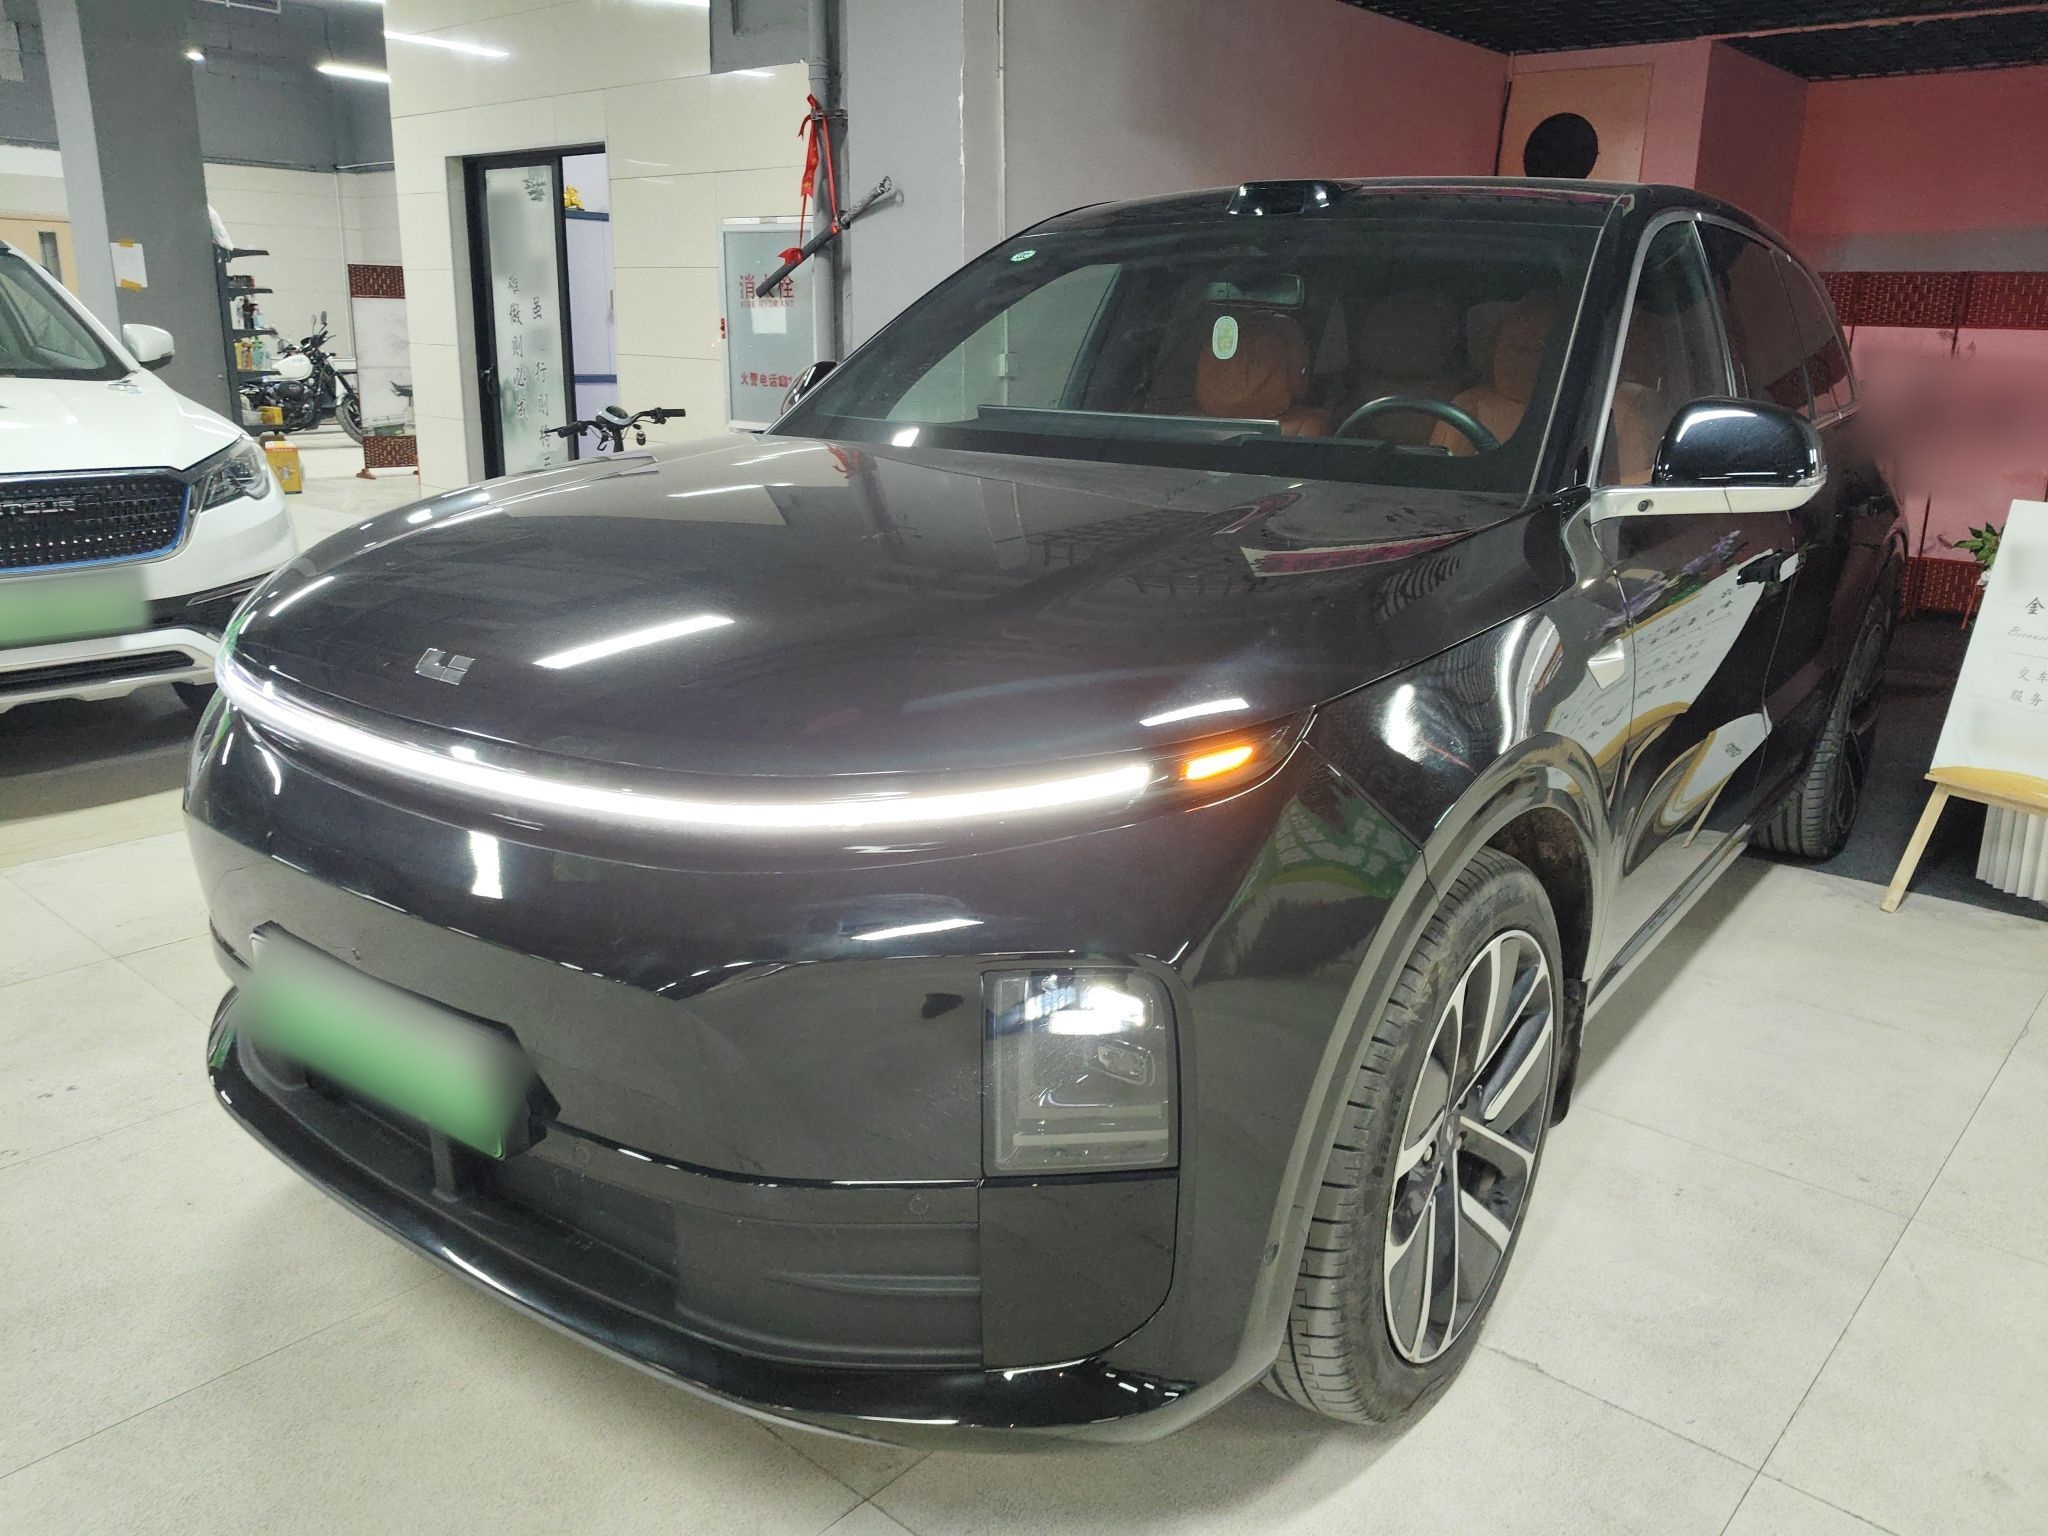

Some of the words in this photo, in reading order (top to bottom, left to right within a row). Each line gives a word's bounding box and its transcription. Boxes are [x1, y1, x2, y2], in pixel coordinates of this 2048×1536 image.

[531, 295, 552, 468] 虽行则将
[0, 500, 79, 516] TOUR
[2025, 596, 2046, 616] 金
